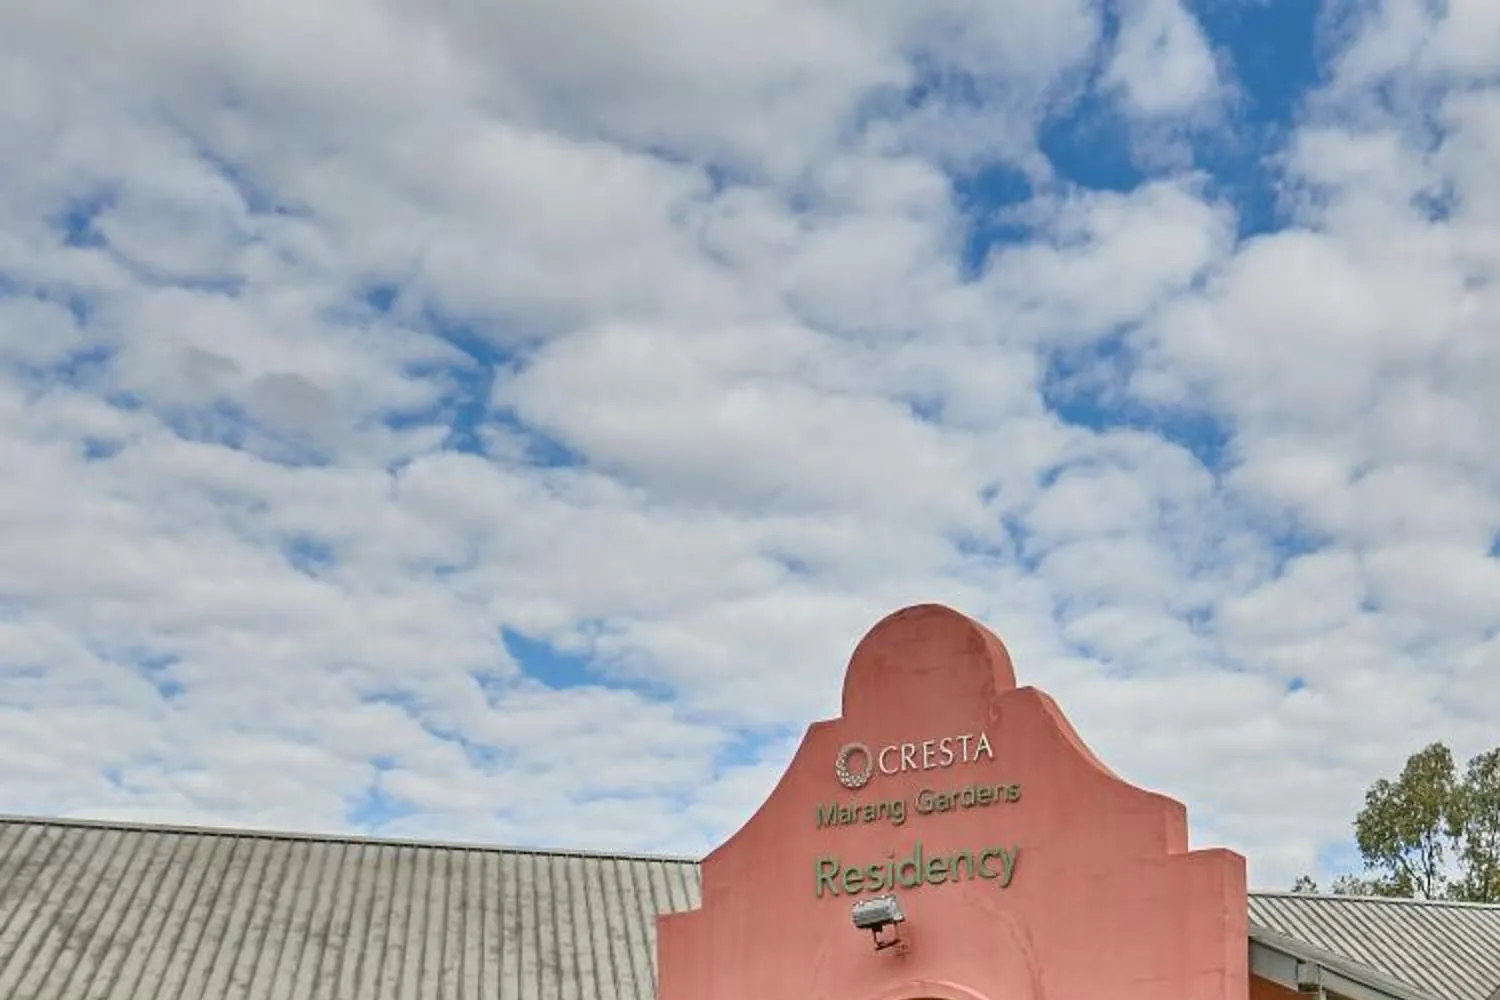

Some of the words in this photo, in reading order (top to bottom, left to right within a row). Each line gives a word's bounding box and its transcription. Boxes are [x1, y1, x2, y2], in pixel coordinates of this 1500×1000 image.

[879, 732, 995, 775] CRESTA
[815, 800, 907, 828] Marang
[915, 782, 1022, 815] Gardens
[814, 839, 1018, 899] Residency
